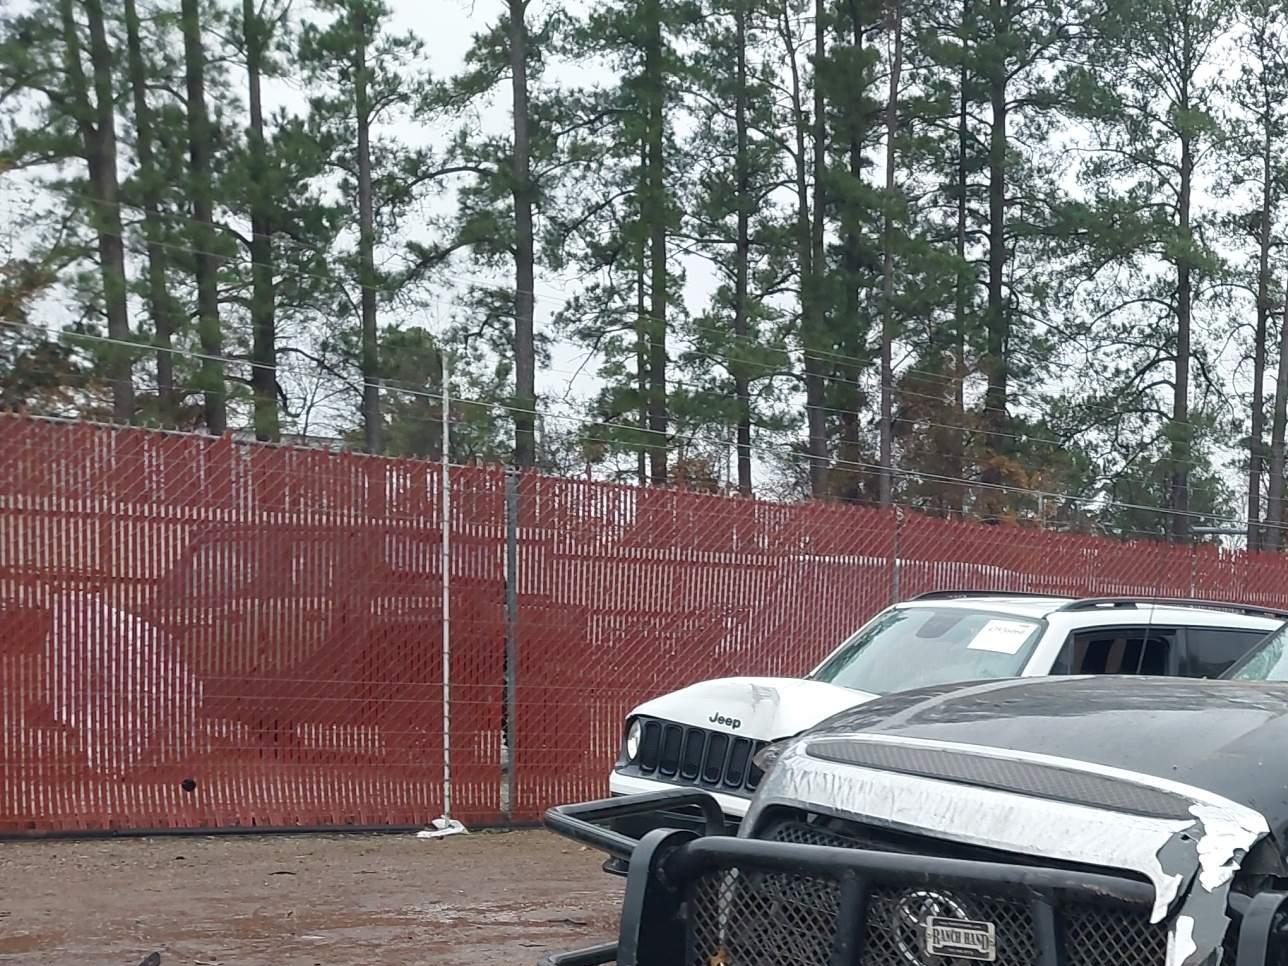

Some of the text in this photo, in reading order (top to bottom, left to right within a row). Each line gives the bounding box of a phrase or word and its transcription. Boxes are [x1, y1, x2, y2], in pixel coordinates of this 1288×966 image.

[708, 712, 741, 730] Jeep
[933, 928, 989, 951] RANCH HAND
